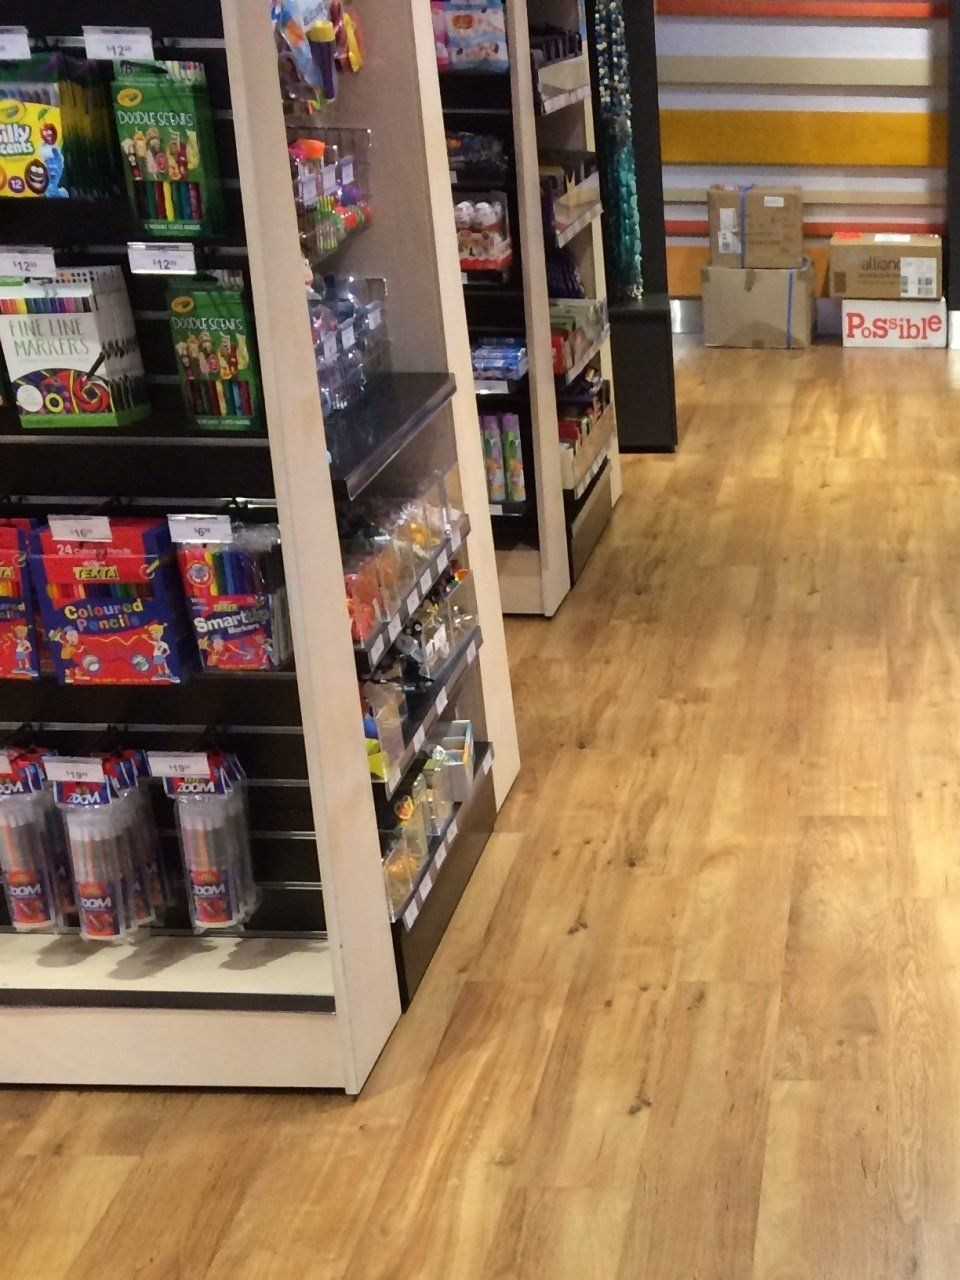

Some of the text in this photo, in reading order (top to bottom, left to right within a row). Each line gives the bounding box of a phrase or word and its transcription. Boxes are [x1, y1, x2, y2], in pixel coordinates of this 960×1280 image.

[9, 318, 84, 338] FINE LINE
[13, 338, 90, 357] MARKERS
[56, 543, 74, 556] 24
[64, 598, 144, 620] Coloured
[76, 614, 141, 632] Pencils
[177, 781, 215, 793] ZOOM
[66, 791, 100, 804] ZOOM
